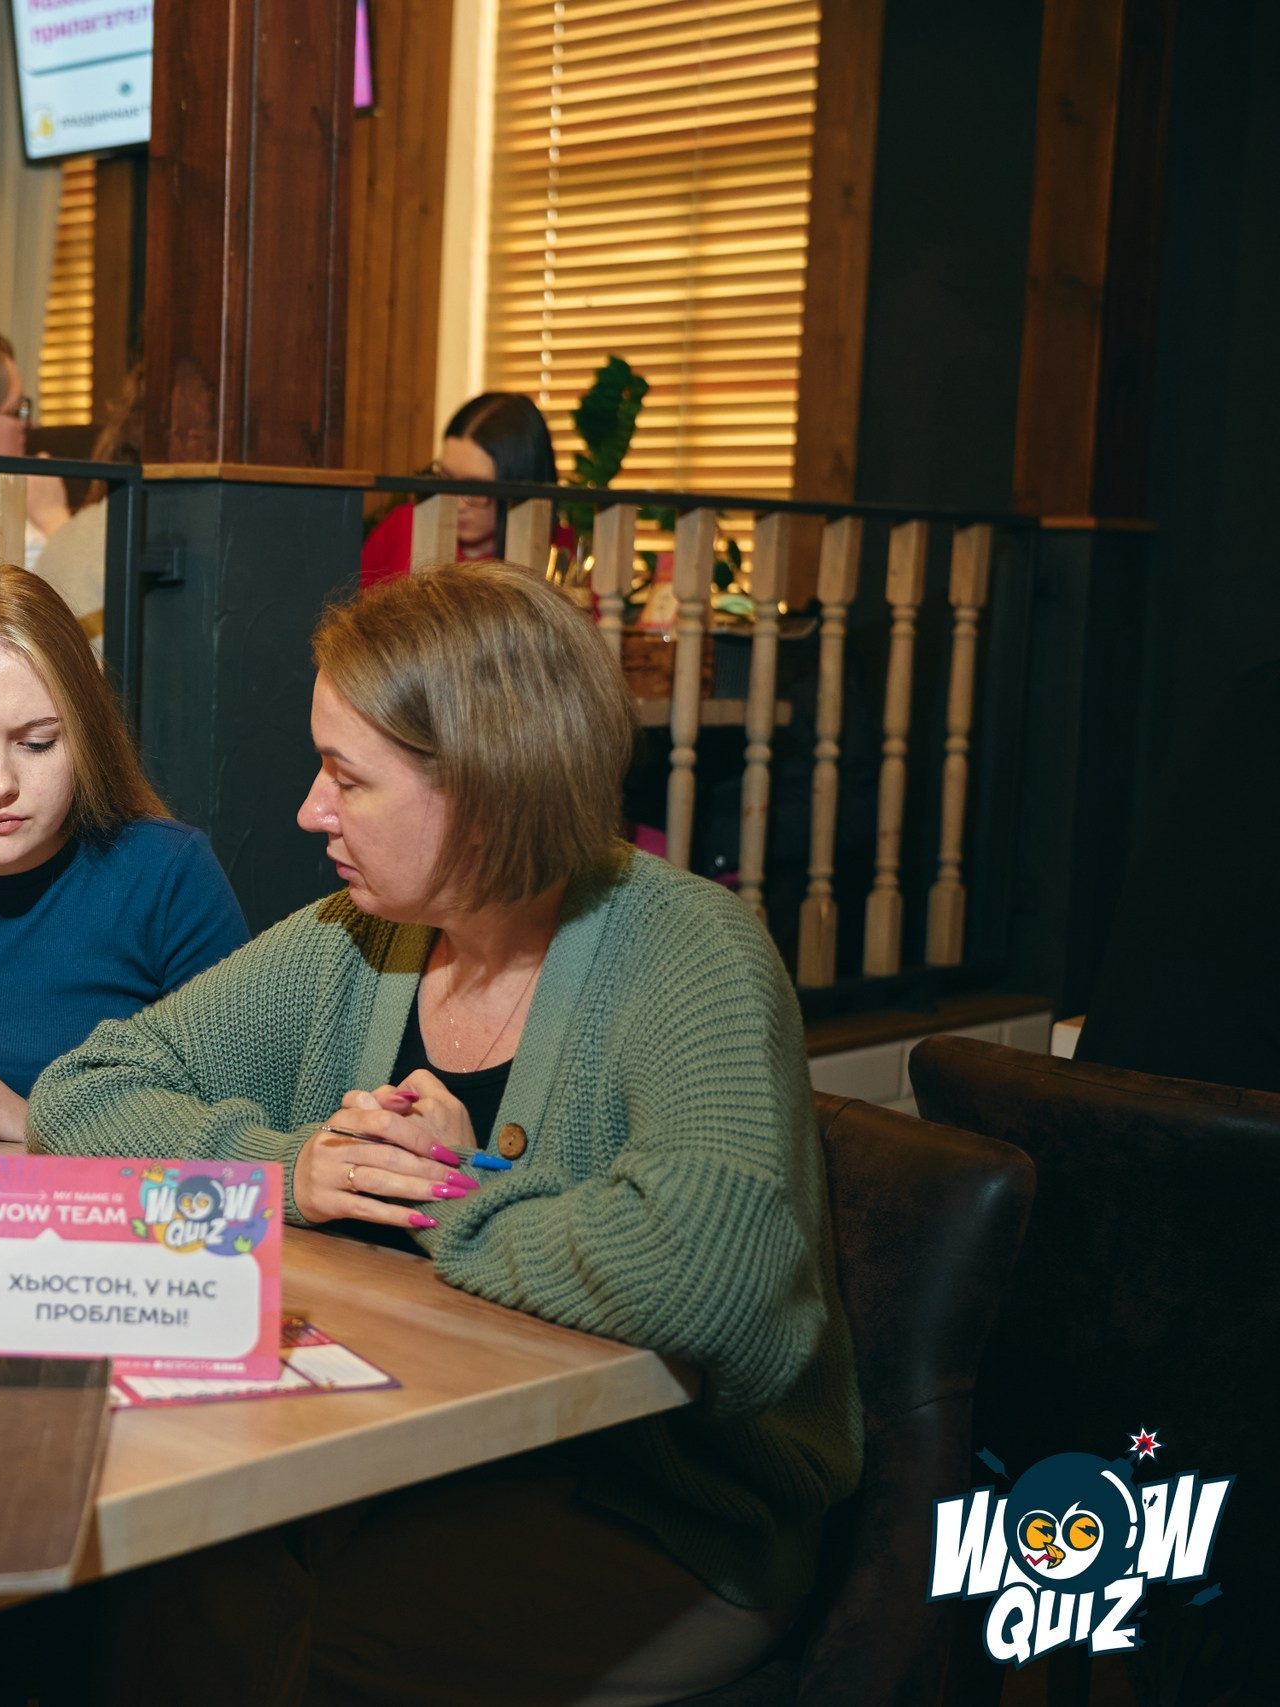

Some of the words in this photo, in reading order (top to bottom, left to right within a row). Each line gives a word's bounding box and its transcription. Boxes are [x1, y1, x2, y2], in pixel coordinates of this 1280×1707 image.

[53, 1190, 72, 1201] MY
[74, 1191, 109, 1202] NAME
[112, 1193, 124, 1203] IS
[145, 1176, 260, 1224] WOW
[56, 1205, 127, 1226] TEAM
[165, 1218, 225, 1249] QUIZ
[9, 1272, 137, 1297] ХЬЮСТОН,
[145, 1278, 161, 1297] У
[168, 1280, 217, 1299] НАС
[35, 1304, 190, 1325] ПРОБЛЕМЫ!
